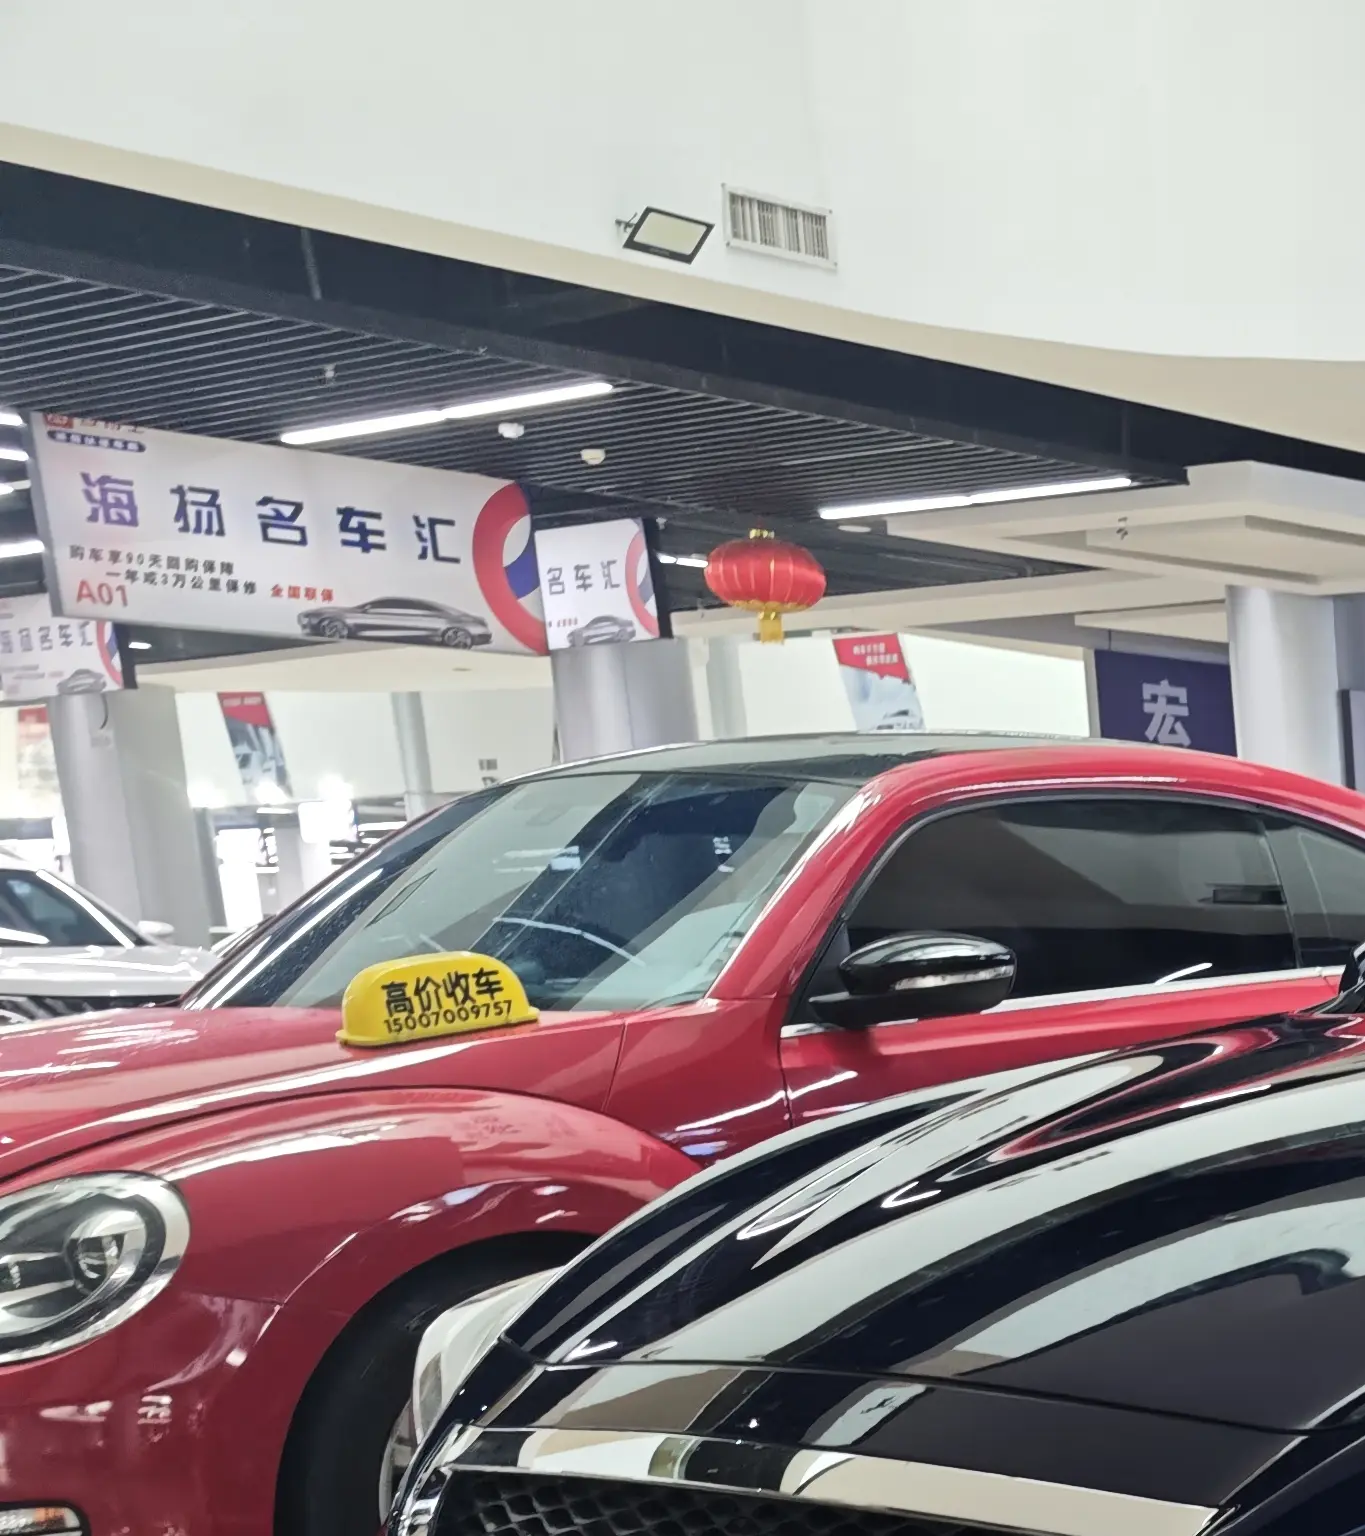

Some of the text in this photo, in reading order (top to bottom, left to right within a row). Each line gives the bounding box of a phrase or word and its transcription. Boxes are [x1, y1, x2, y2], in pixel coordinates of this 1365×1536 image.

[80, 471, 462, 565] 海扬名车汇
[76, 579, 128, 608] A01
[547, 559, 621, 596] 名车汇
[1142, 678, 1192, 748] 宏
[381, 967, 504, 1018] 高价收车
[383, 999, 513, 1034] 15007009757
